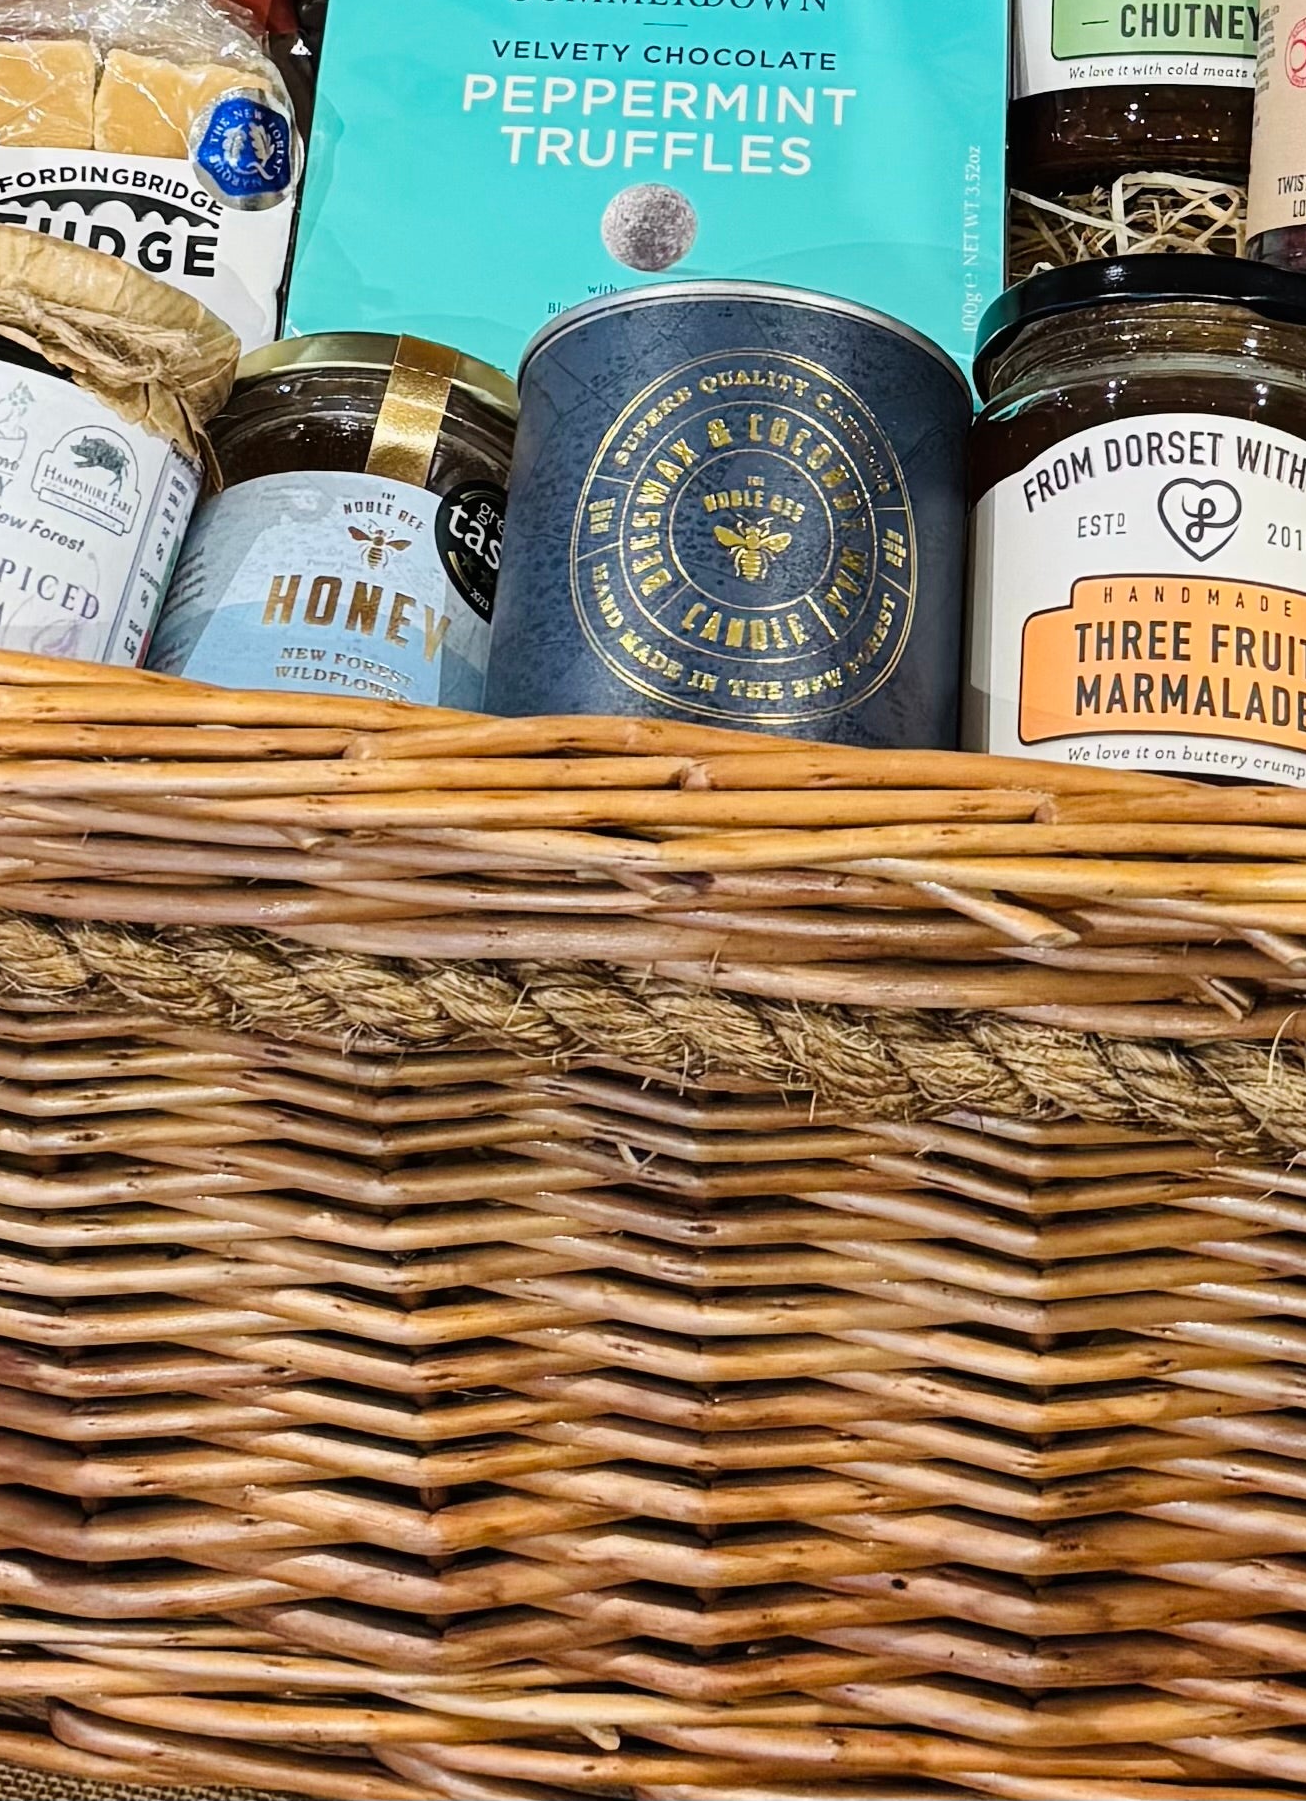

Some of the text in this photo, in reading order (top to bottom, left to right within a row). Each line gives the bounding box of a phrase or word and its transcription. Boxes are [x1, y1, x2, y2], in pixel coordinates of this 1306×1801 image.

[491, 39, 839, 72] VELVETY CHOCOLATE
[461, 71, 858, 128] PEPPERMINT
[500, 123, 815, 178] TRUFFLES
[261, 574, 452, 663] HONEY
[1074, 620, 1192, 663] THREE
